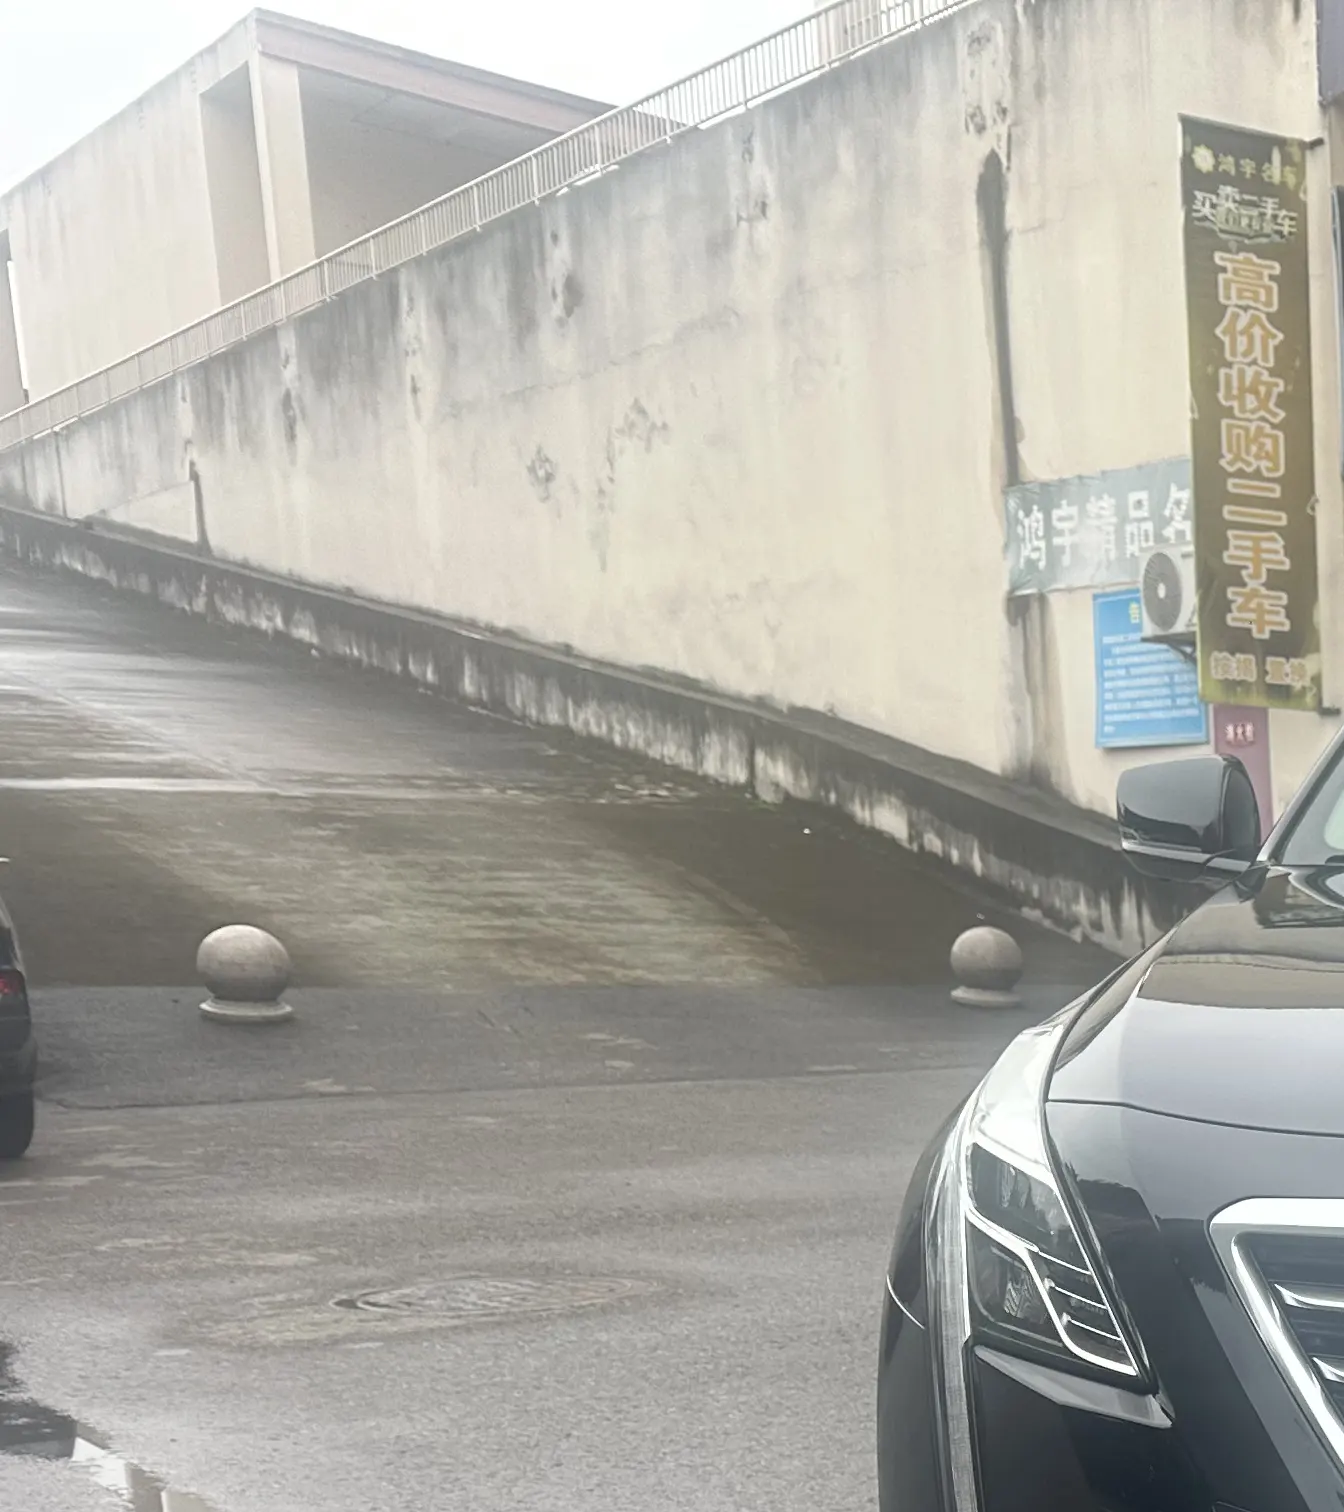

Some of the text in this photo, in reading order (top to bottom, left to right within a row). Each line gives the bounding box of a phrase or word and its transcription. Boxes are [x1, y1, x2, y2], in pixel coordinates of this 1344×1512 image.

[1017, 482, 1192, 570] 鸿宇精品名
[1212, 249, 1292, 640] 高价收购二手车
